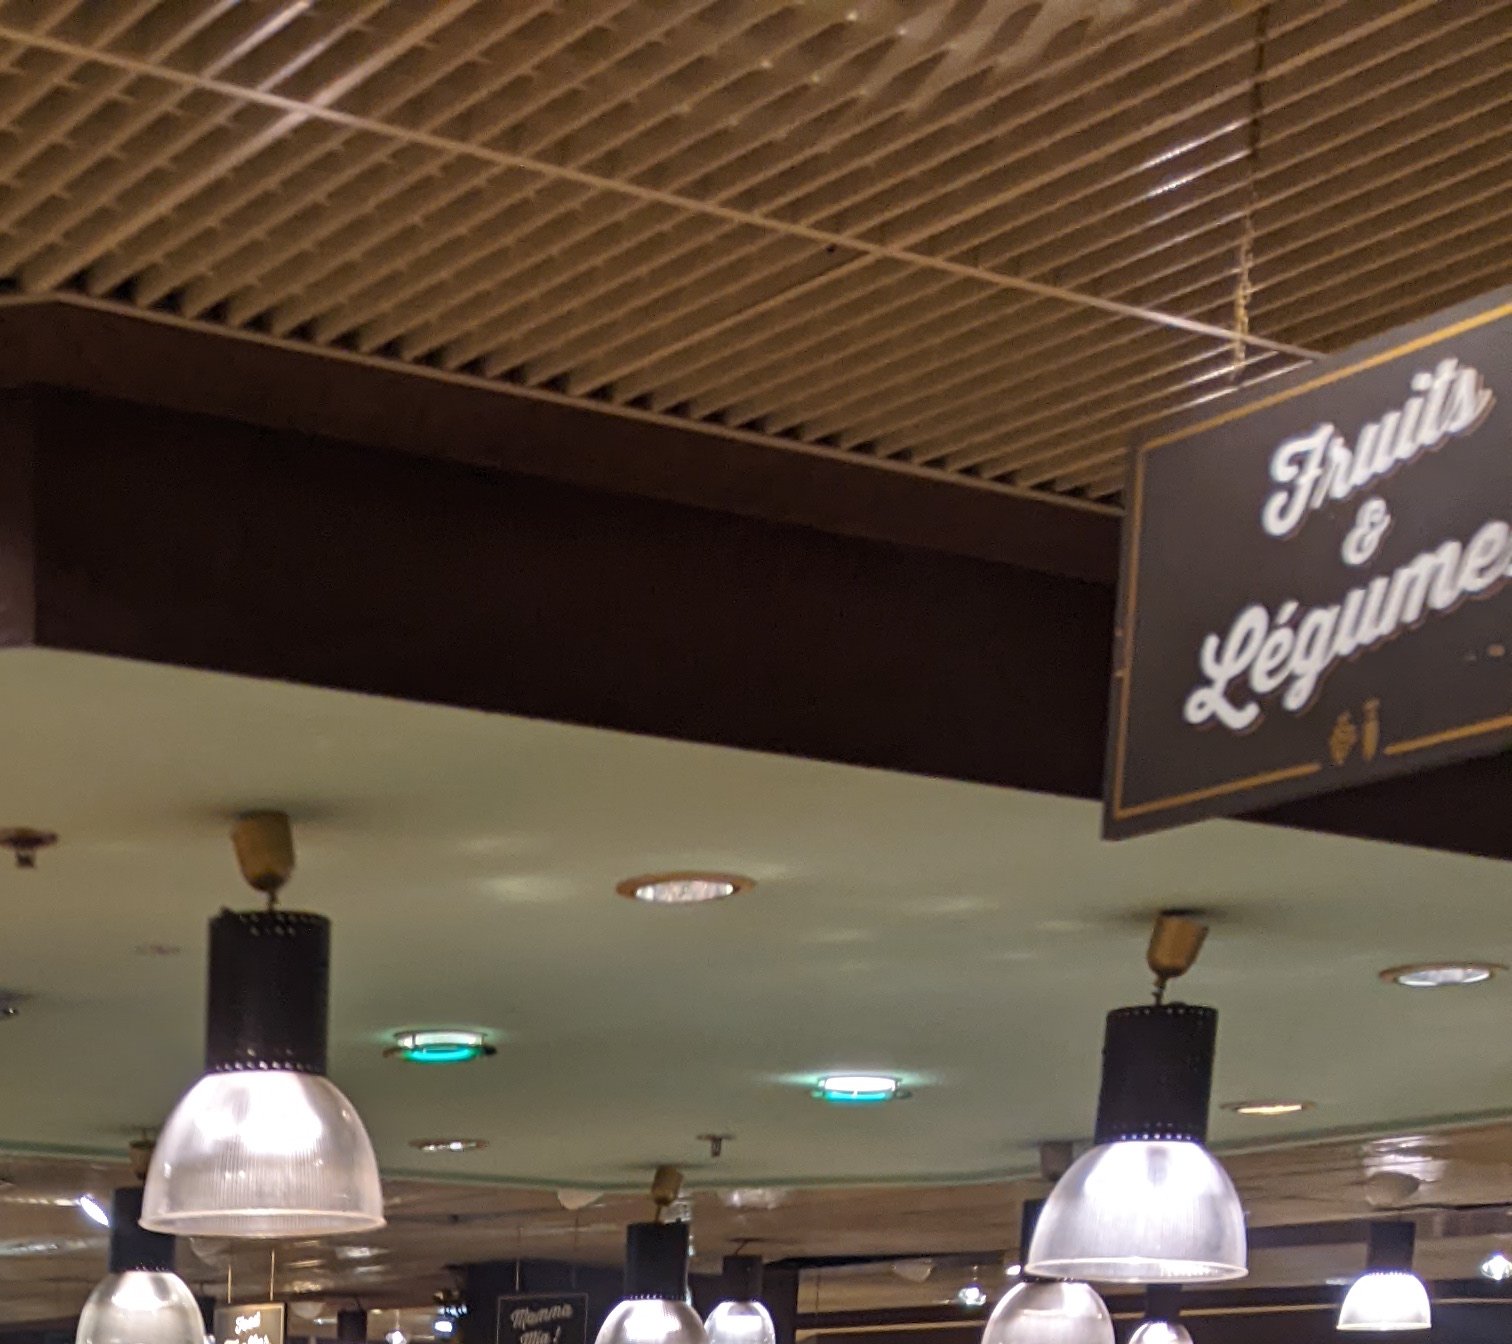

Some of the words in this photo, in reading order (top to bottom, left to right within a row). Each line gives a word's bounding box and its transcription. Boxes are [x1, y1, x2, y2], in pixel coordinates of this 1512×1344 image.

[1262, 357, 1493, 536] Fruits
[1341, 498, 1390, 566] &
[1184, 519, 1512, 730] Légume
[510, 1304, 573, 1330] Mamma
